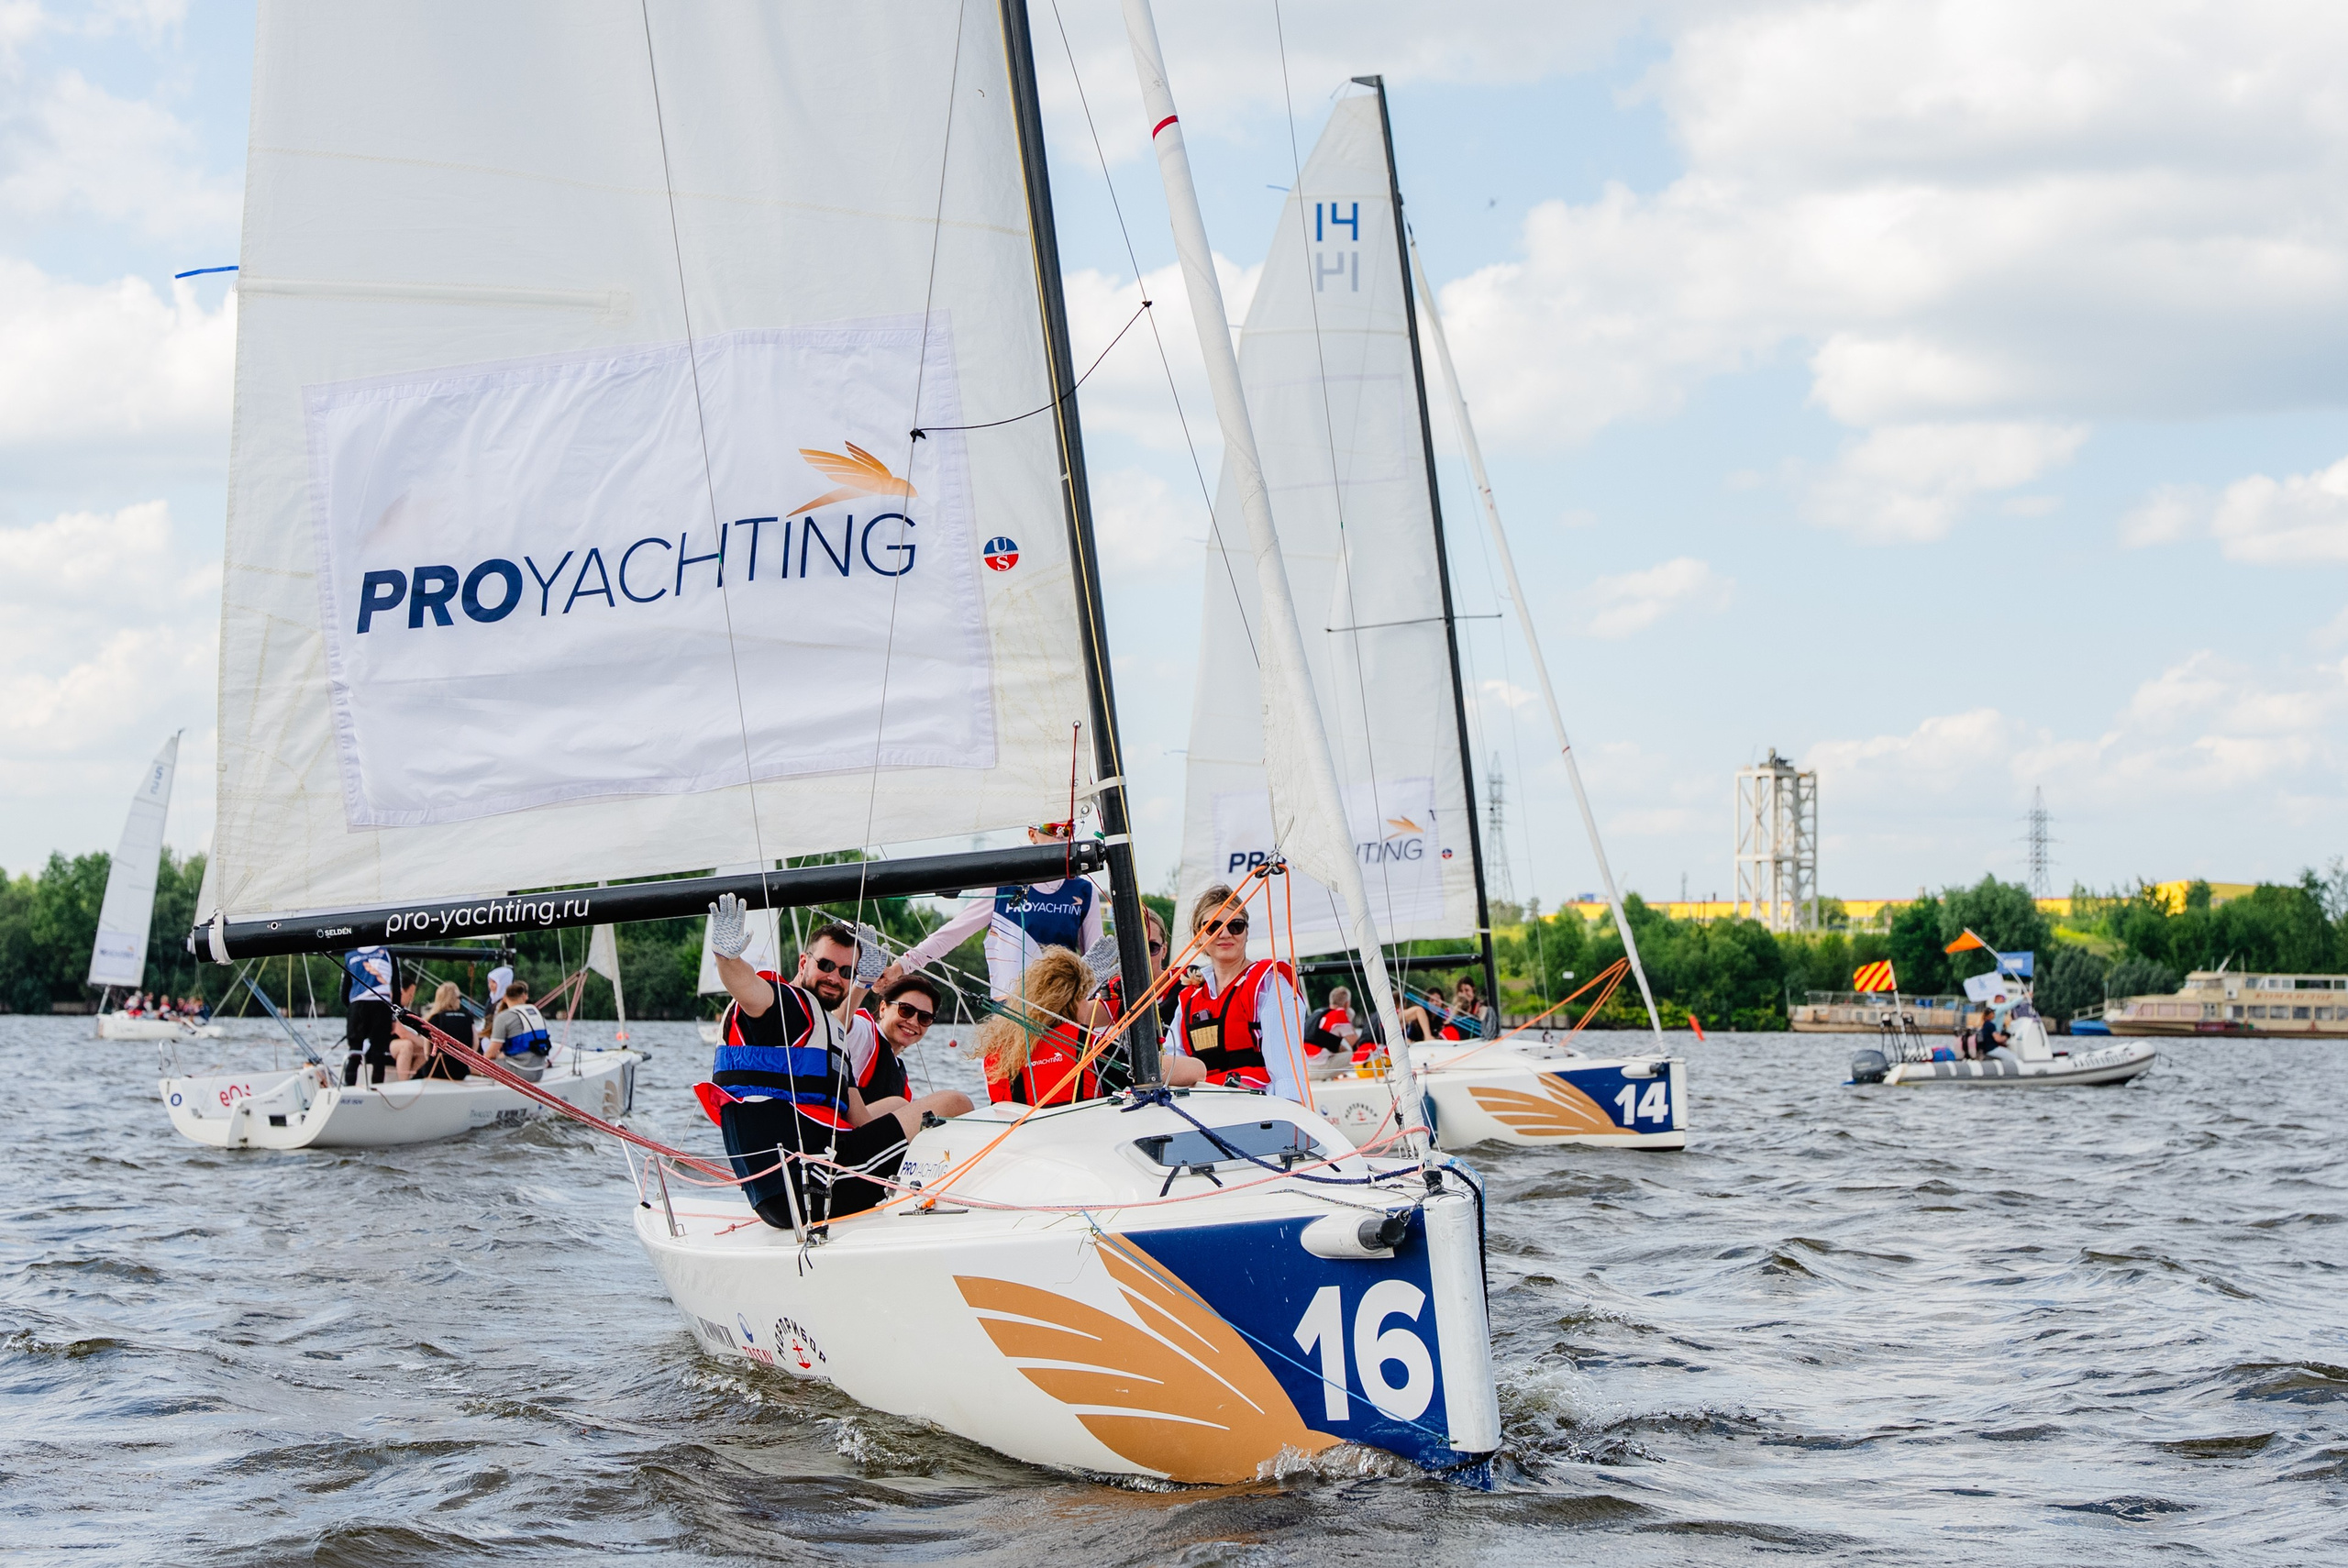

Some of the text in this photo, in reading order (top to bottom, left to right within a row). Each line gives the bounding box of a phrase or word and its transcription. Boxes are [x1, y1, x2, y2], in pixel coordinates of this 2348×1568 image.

[1316, 203, 1358, 241] 14
[356, 513, 917, 635] PROYACHTING
[385, 899, 590, 938] pro-yachting.ru
[1614, 1081, 1669, 1125] 14
[774, 1317, 826, 1364] МОРПРИБОР
[1293, 1279, 1434, 1421] 16
